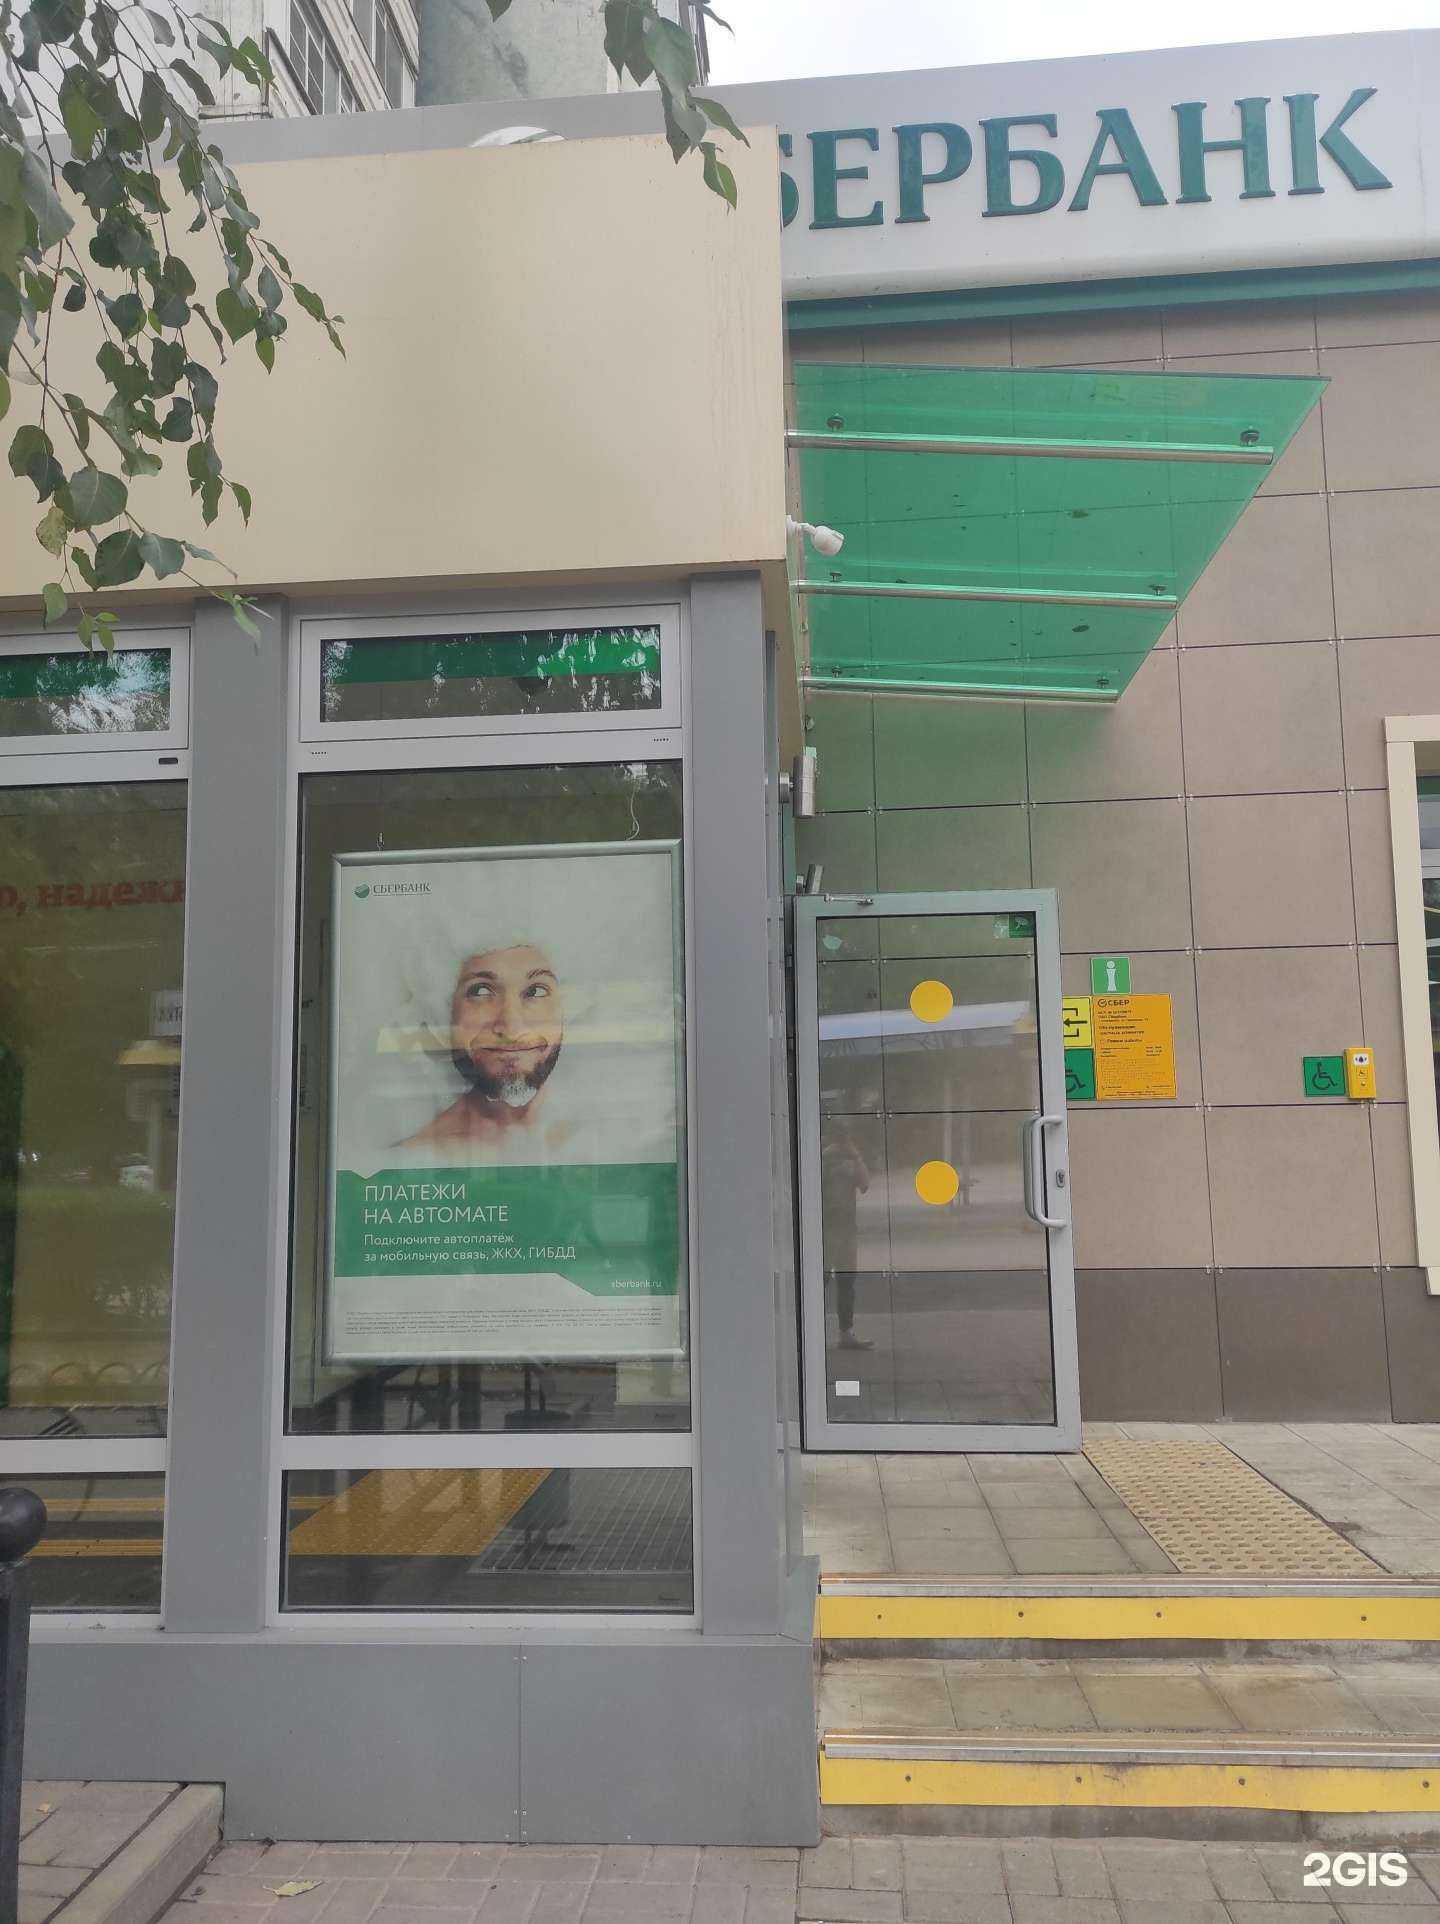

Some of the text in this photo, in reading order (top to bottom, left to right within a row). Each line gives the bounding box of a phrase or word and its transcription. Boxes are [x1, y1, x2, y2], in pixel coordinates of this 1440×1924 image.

[373, 882, 432, 894] СБЕРБАНК
[1107, 999, 1131, 1007] СБЕР
[364, 1184, 466, 1202] ПЛАТЕЖИ
[364, 1205, 509, 1225] НА АВТОМАТЕ
[364, 1232, 515, 1248] Подключите автоплатёж
[364, 1246, 577, 1264] за мобильную связь, ЖКХ, ГИБДД
[610, 1279, 663, 1290] sberbank.ru
